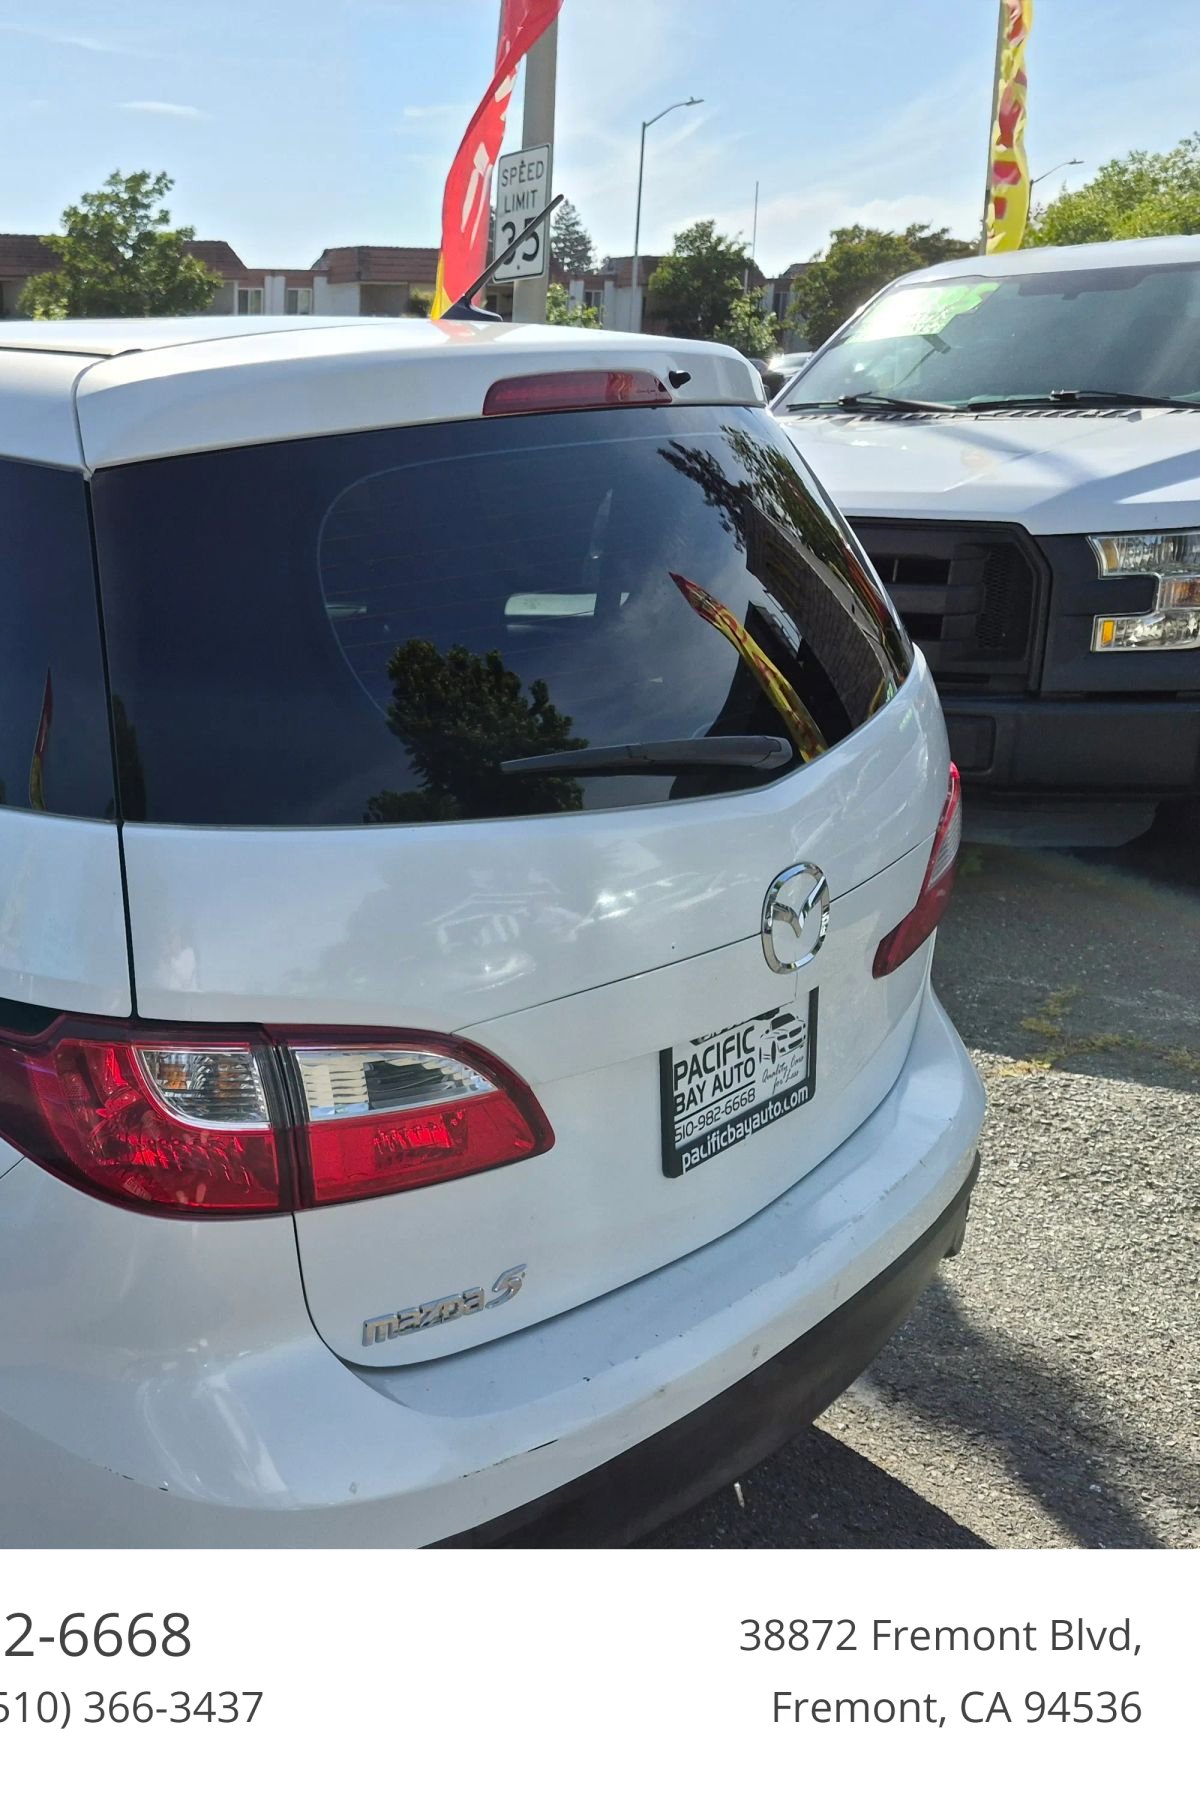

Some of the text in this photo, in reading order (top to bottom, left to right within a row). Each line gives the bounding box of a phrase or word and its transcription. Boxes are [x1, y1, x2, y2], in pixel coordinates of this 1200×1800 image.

[502, 160, 544, 187] SPEED
[504, 189, 538, 213] LIMIT
[501, 216, 540, 266] 35
[673, 1026, 755, 1091] PACIFIC
[674, 1057, 756, 1115] BAY AUTO
[674, 1087, 756, 1144] 510-982-6668
[682, 1086, 809, 1174] pacificbayauto.com
